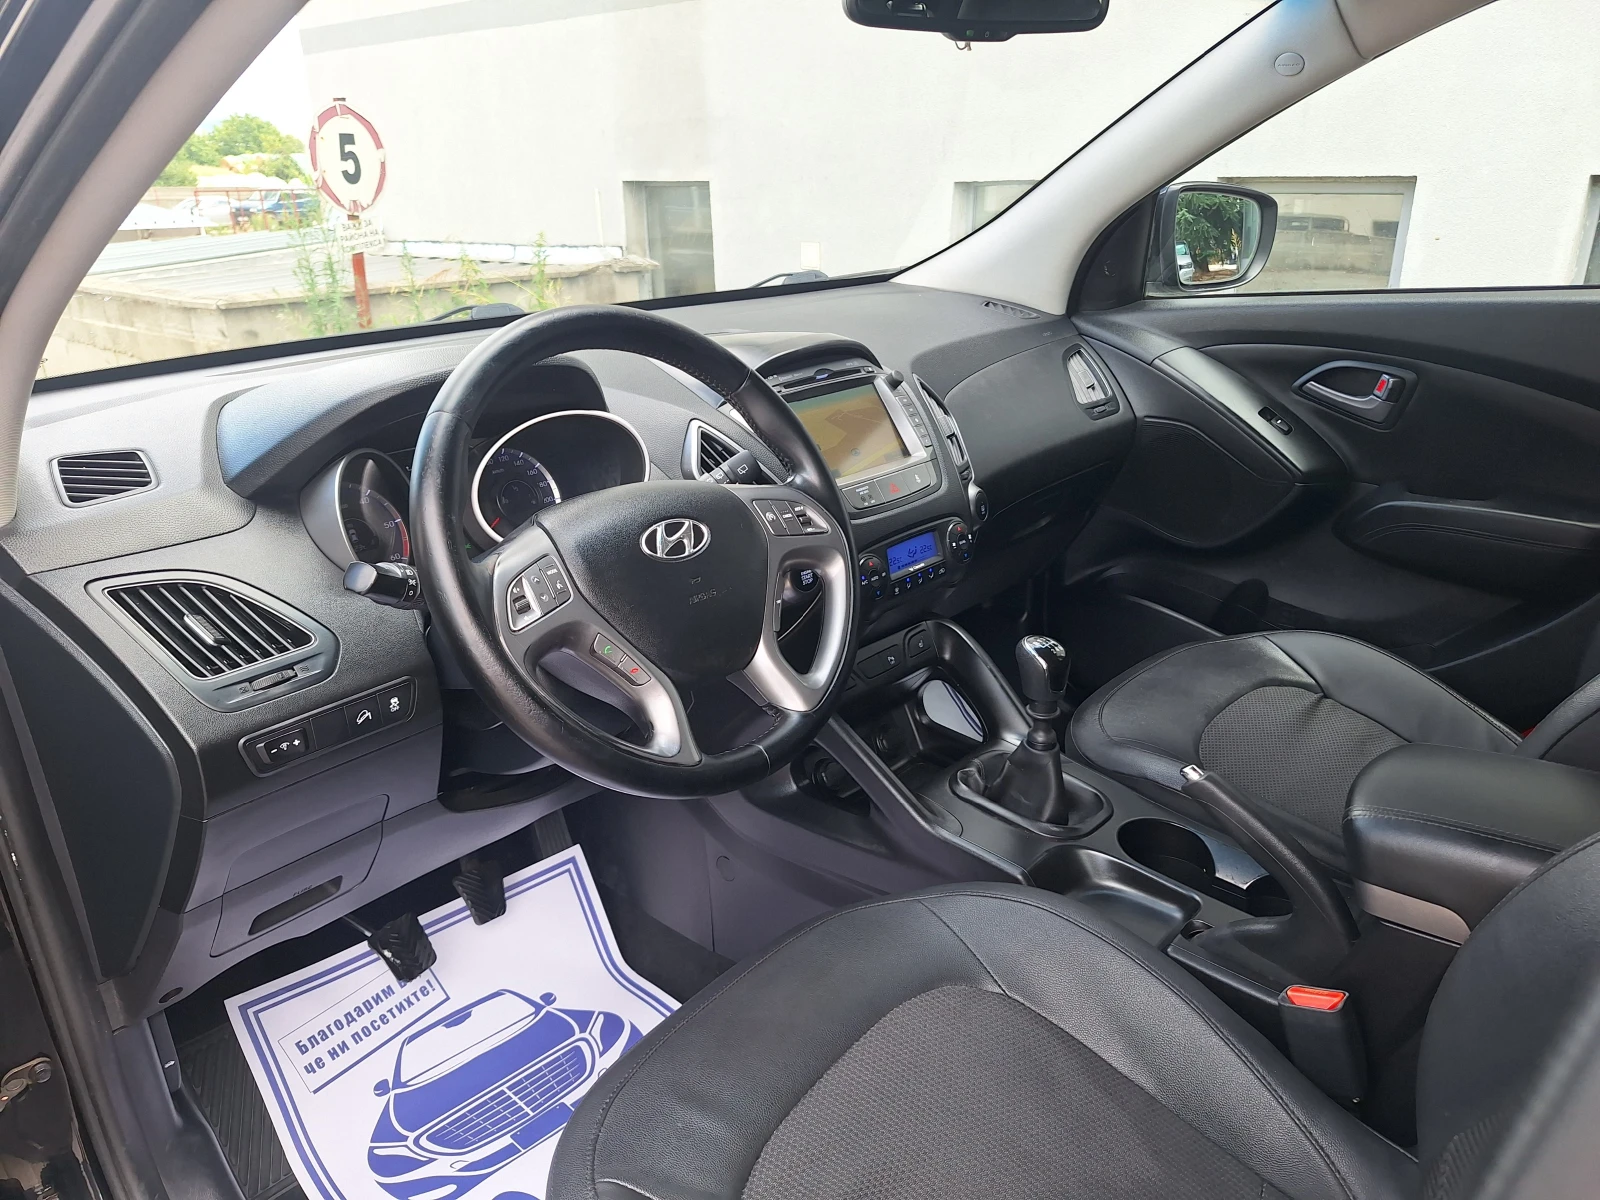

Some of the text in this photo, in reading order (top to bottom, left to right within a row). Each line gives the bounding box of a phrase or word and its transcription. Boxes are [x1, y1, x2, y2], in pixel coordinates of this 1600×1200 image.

[338, 133, 362, 185] 5
[513, 459, 525, 467] 140
[526, 468, 538, 476] 160
[359, 497, 370, 505] 40
[383, 520, 395, 529] 50
[390, 552, 401, 561] 60
[802, 577, 814, 586] STOP
[294, 984, 396, 1056] Благодарим
[303, 978, 436, 1075] че ни посетихте!
